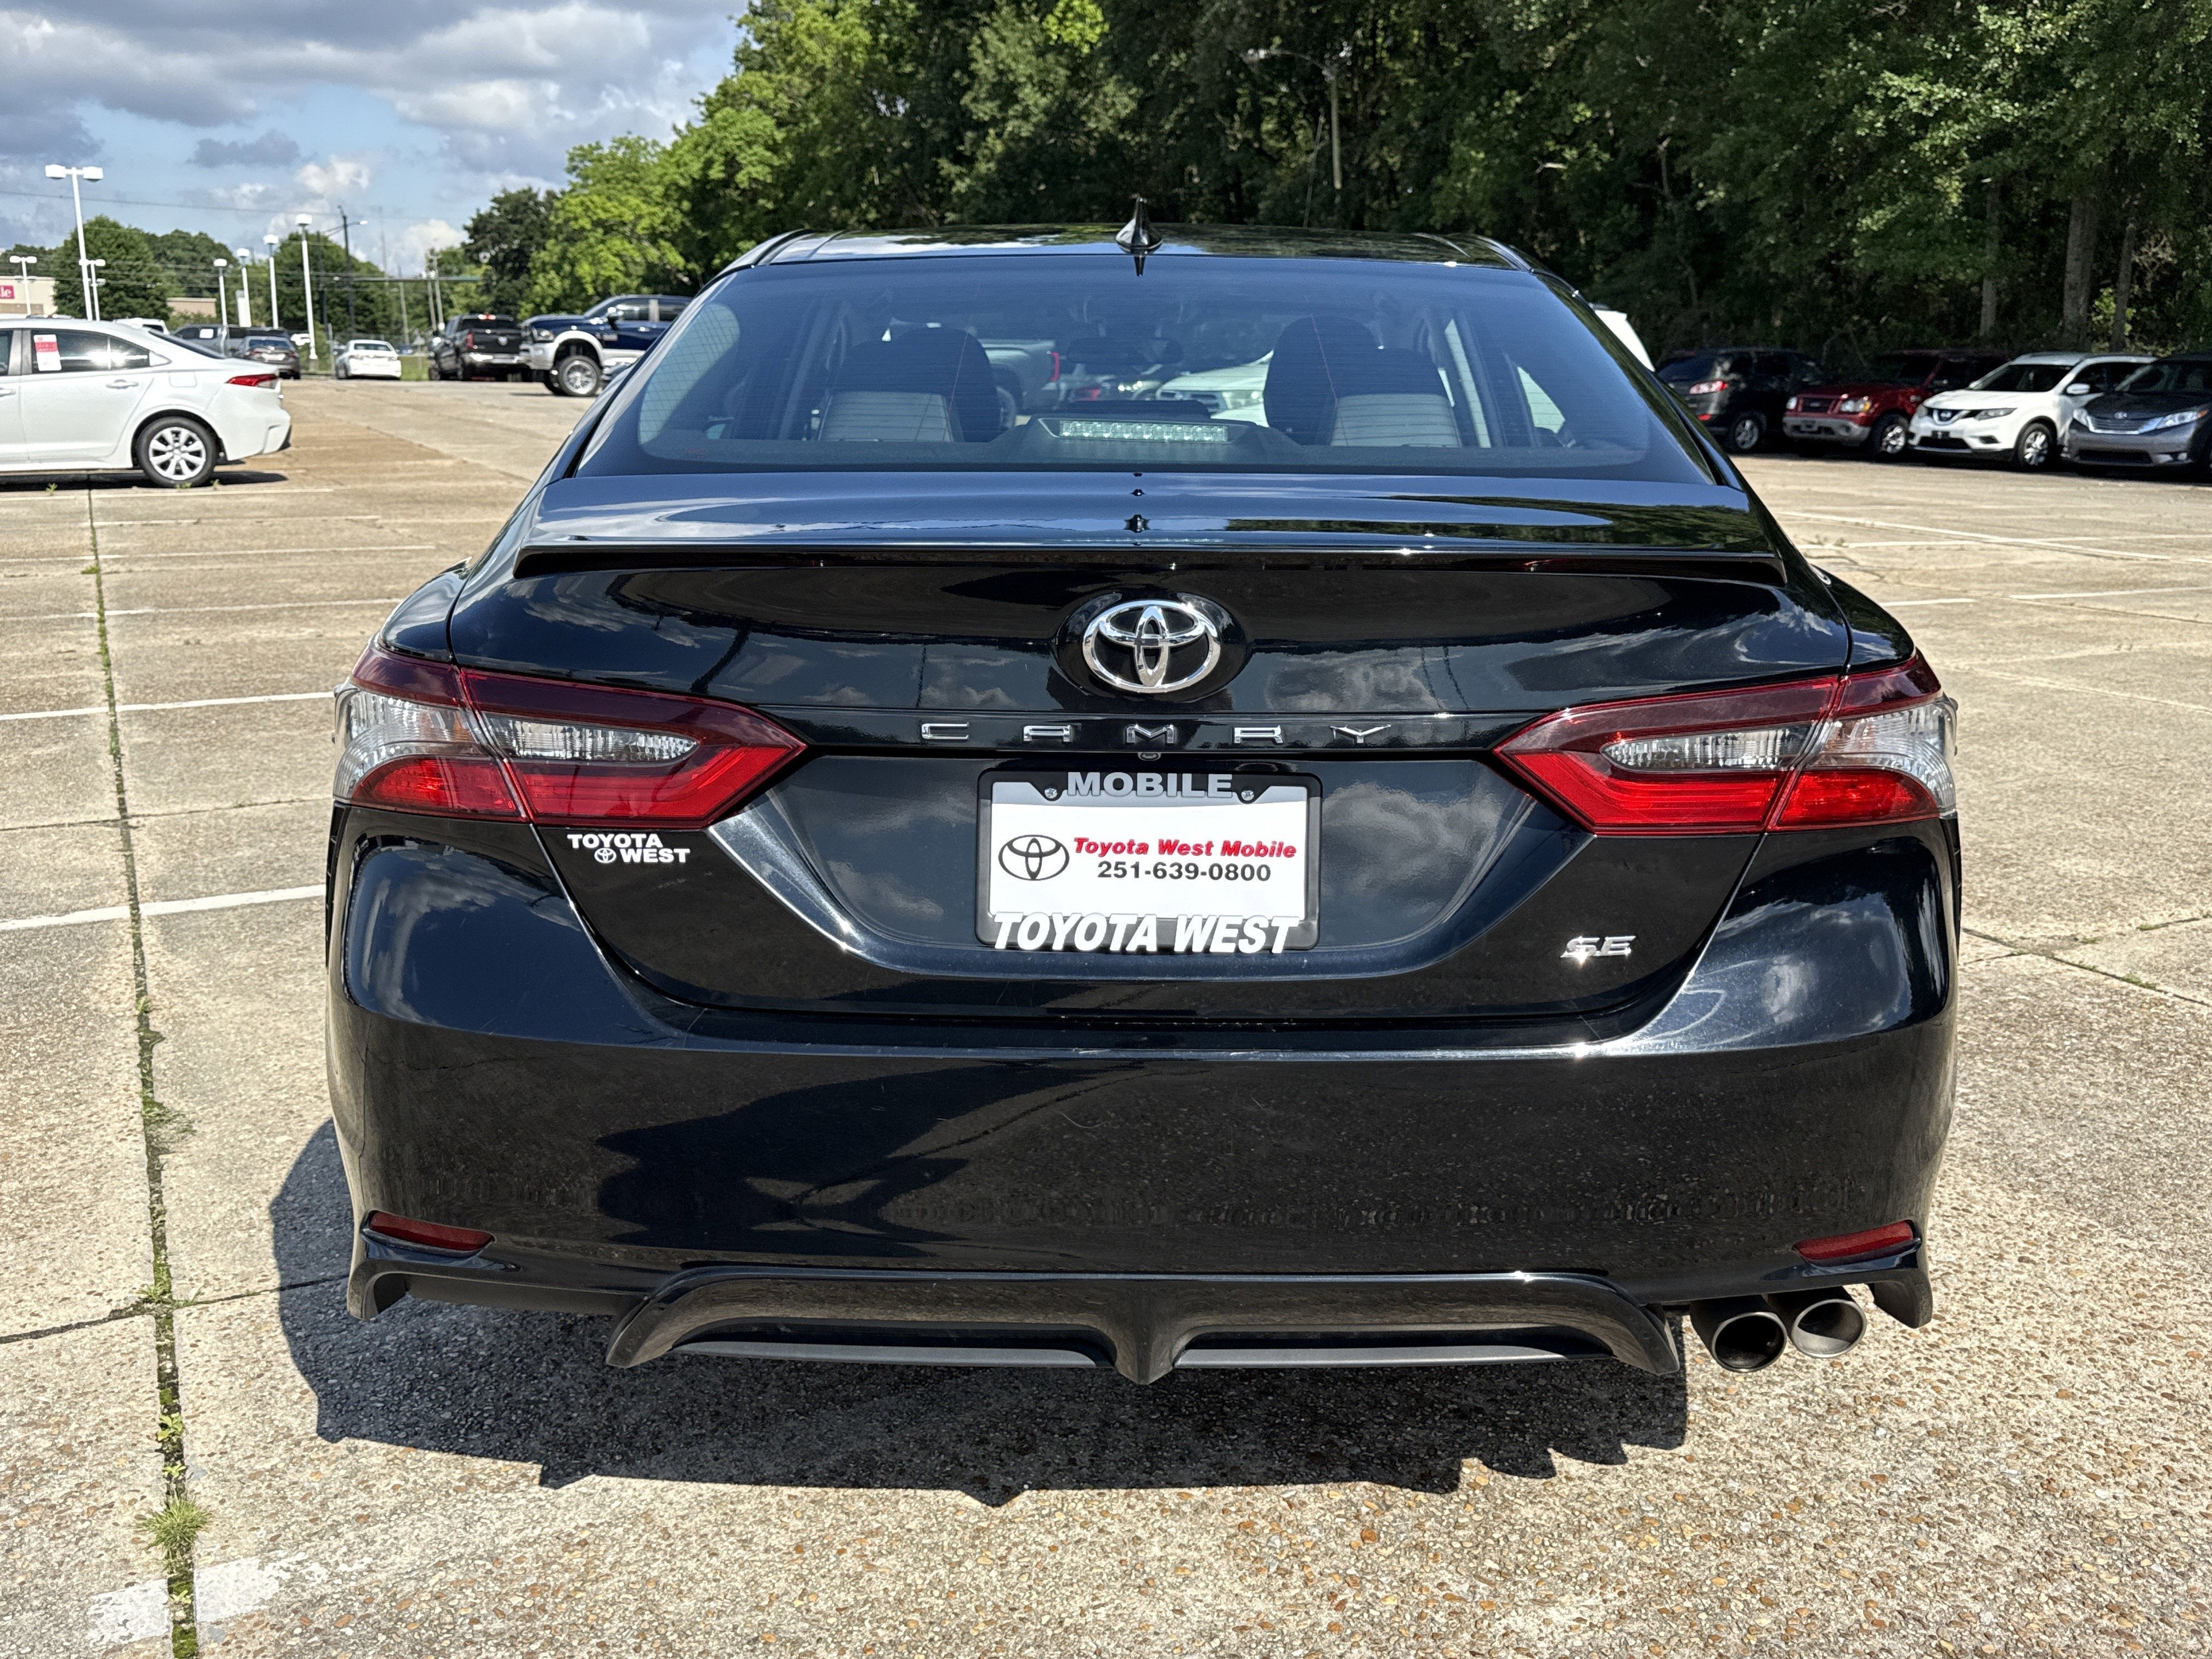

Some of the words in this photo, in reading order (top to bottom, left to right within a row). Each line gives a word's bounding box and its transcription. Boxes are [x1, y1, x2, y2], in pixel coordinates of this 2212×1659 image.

[922, 721, 1391, 744] CAMRY
[1068, 771, 1233, 797] MOBILE
[567, 833, 663, 848] TOYOTA
[1074, 837, 1149, 857] Toyota
[1158, 839, 1214, 856] West
[1220, 840, 1297, 858] Mobile
[619, 848, 690, 863] WEST
[1097, 860, 1271, 882] 251-639-0800
[994, 911, 1158, 952] TOYOTA
[1174, 914, 1300, 954] WEST
[1560, 935, 1637, 958] SE
